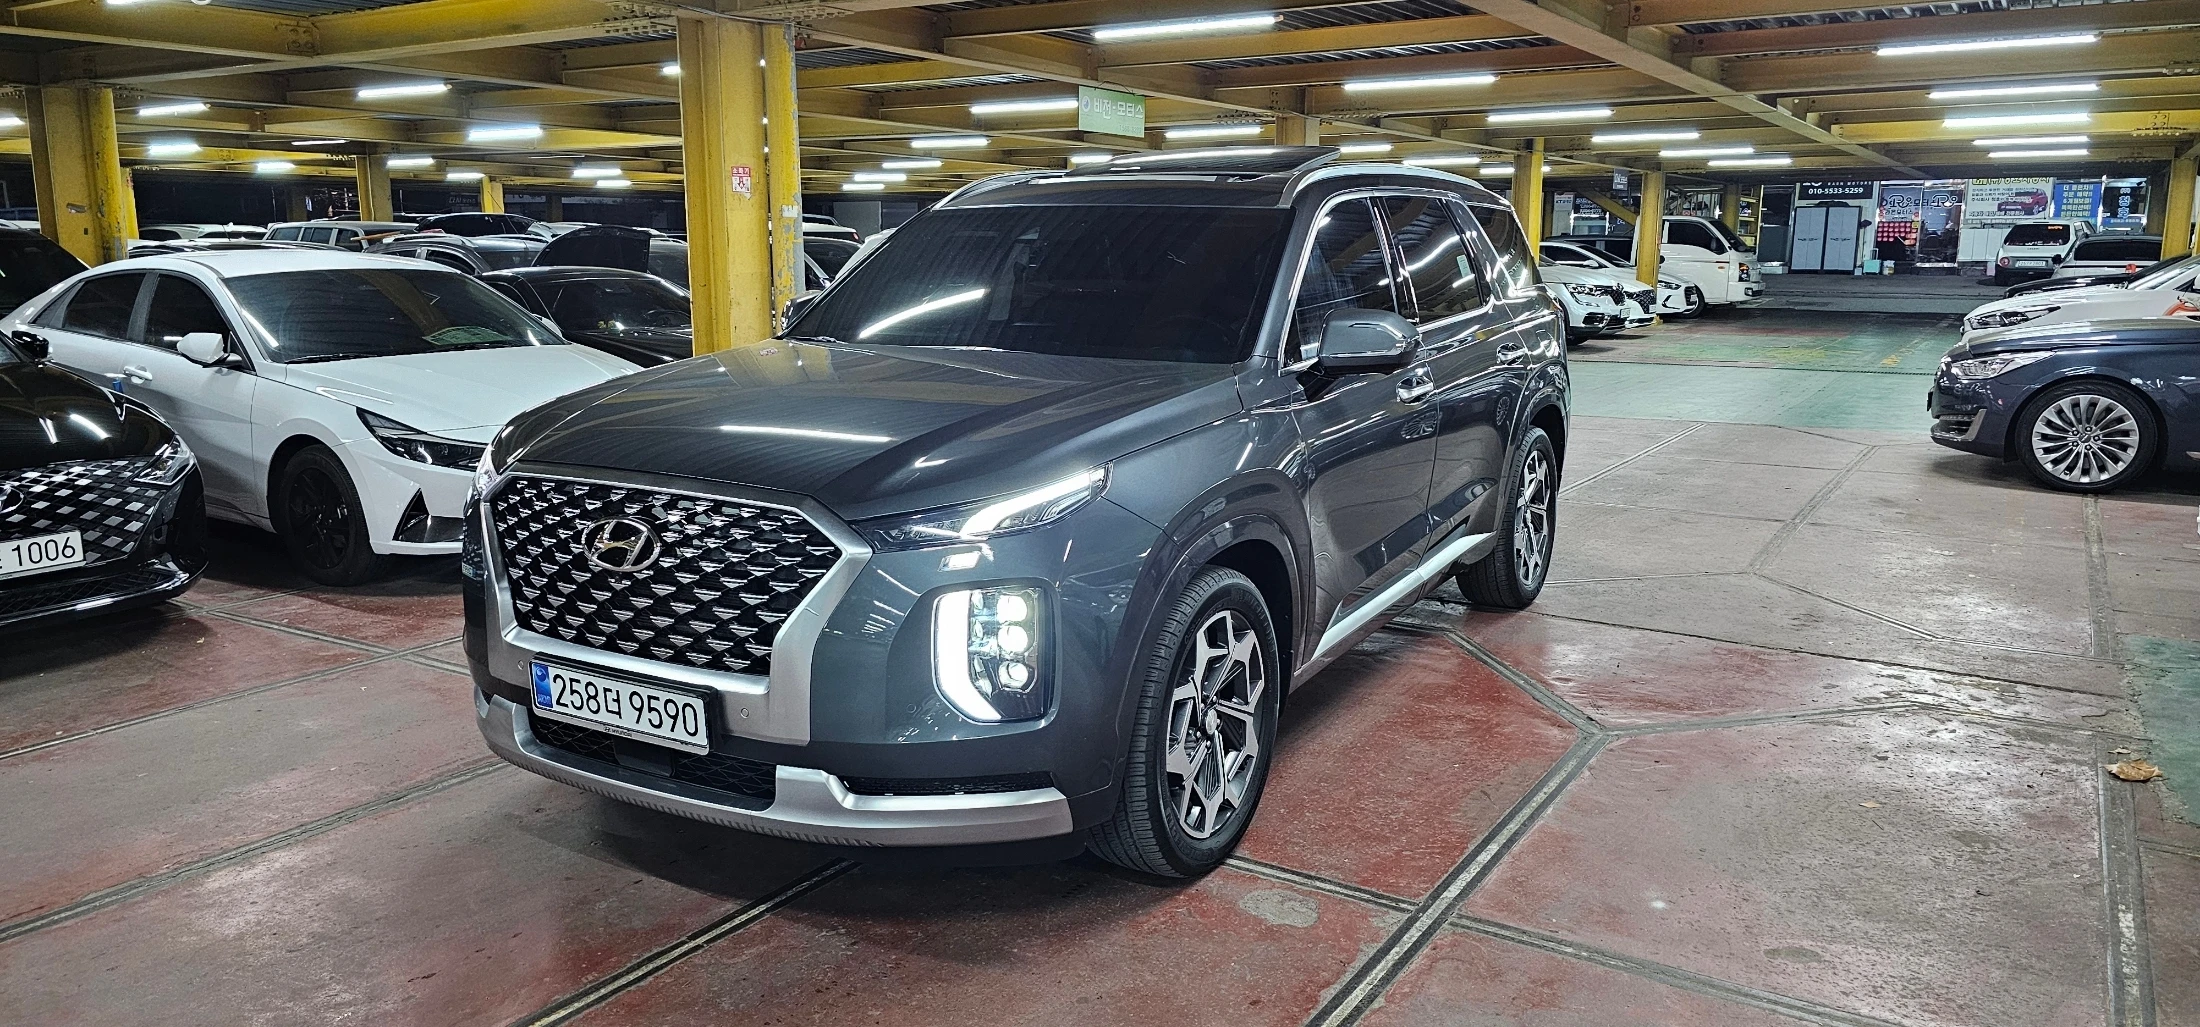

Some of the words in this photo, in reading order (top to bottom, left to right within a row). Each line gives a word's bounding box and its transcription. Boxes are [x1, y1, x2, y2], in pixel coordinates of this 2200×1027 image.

[1808, 187, 1864, 195] 010-5533-5259
[11, 536, 76, 567] 1006
[552, 673, 623, 719] 258더
[628, 690, 699, 737] 9590
